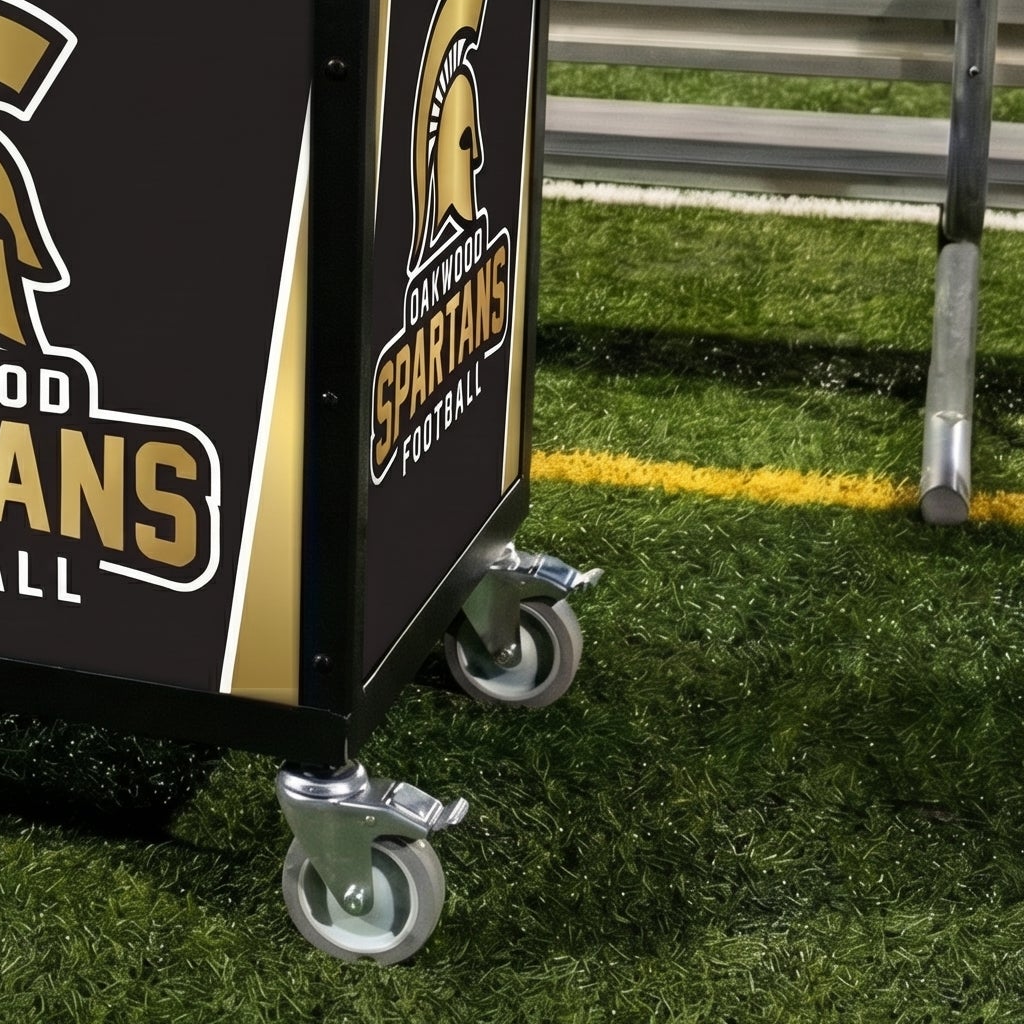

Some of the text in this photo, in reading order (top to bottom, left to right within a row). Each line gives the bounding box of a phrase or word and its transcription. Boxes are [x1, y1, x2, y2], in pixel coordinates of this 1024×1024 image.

[410, 227, 483, 326] OAKWOOD
[376, 245, 506, 466] SPARTANS
[402, 360, 482, 477] FOOTBALL
